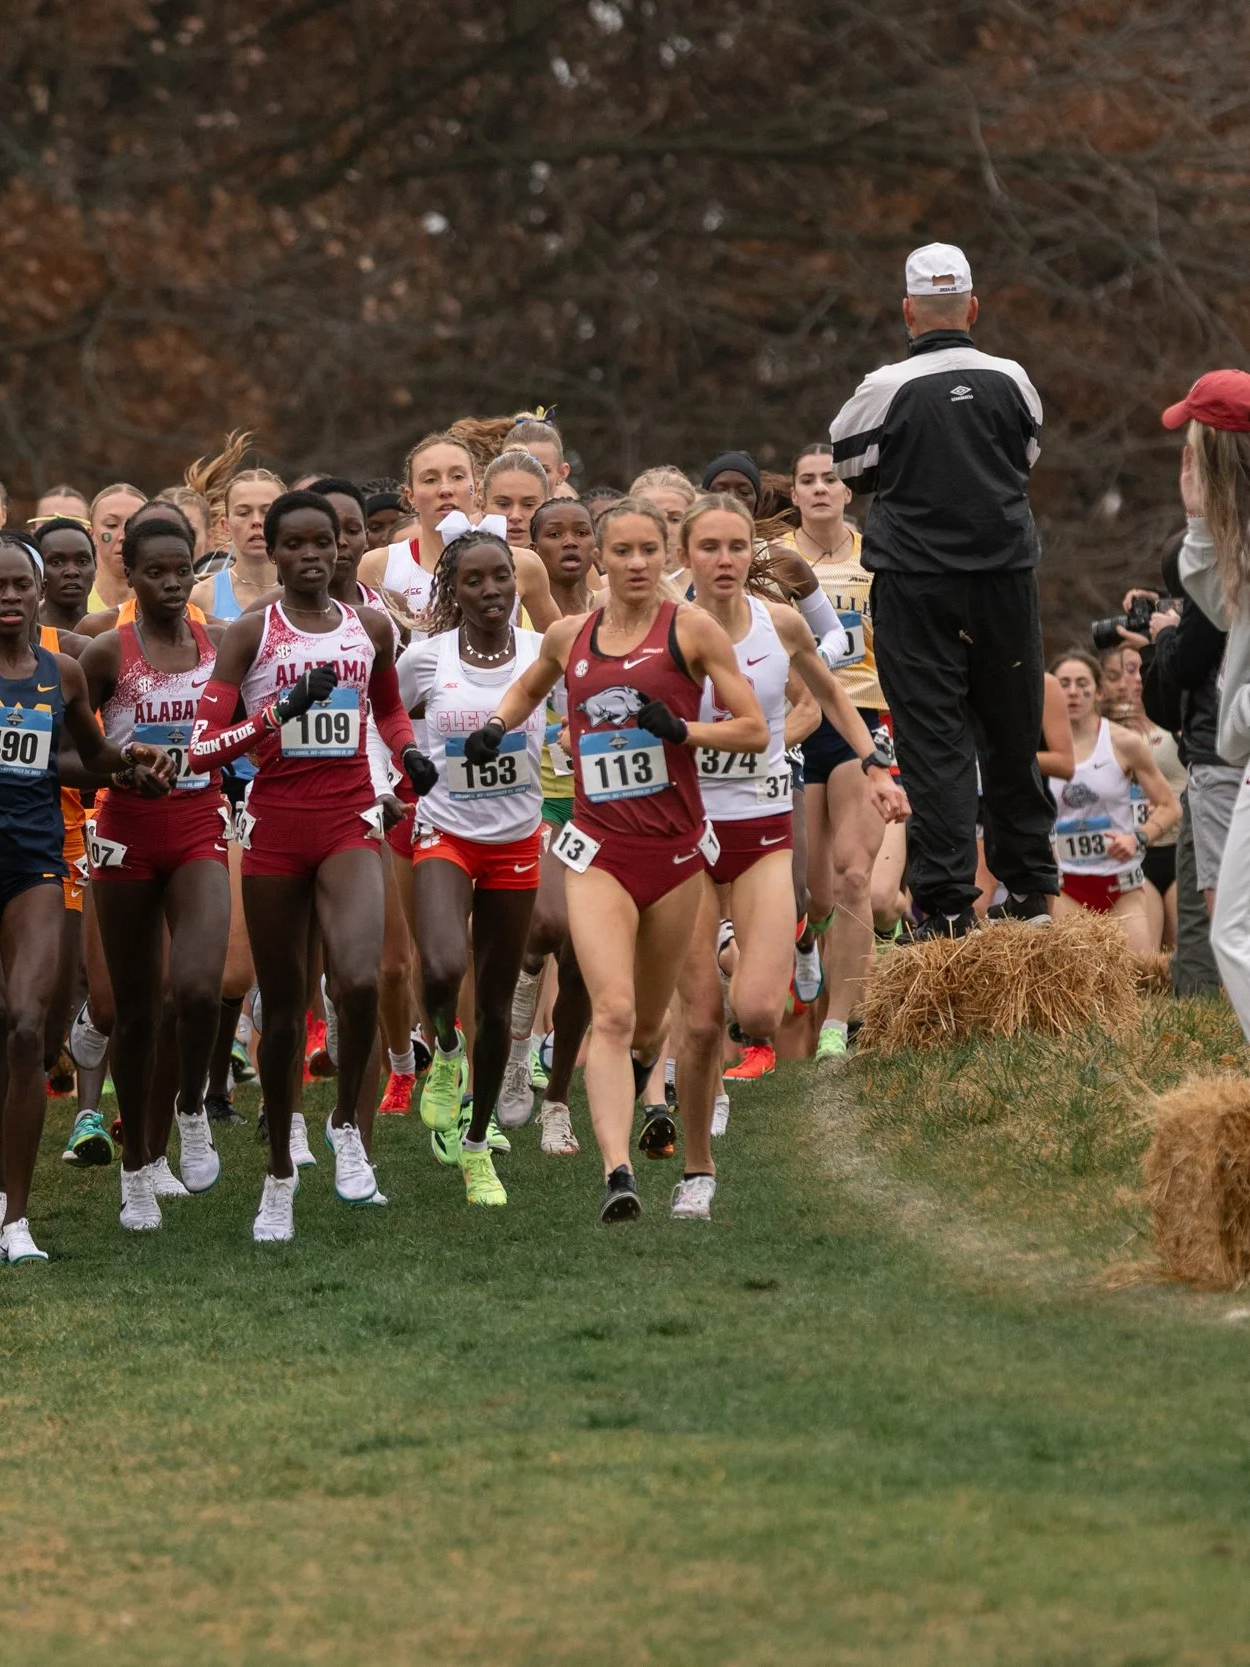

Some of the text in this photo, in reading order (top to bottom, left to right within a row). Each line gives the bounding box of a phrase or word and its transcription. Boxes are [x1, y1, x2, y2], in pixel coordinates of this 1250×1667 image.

[276, 645, 291, 657] SEC
[138, 679, 152, 692] SEC
[134, 699, 199, 724] ALABA
[437, 710, 539, 732] CLEMN
[220, 721, 256, 748] TIDE
[296, 712, 350, 744] 109
[461, 756, 517, 788] 153
[595, 751, 653, 788] 113
[702, 749, 757, 774] 374
[558, 832, 586, 861] 13
[1065, 833, 1105, 857] 193
